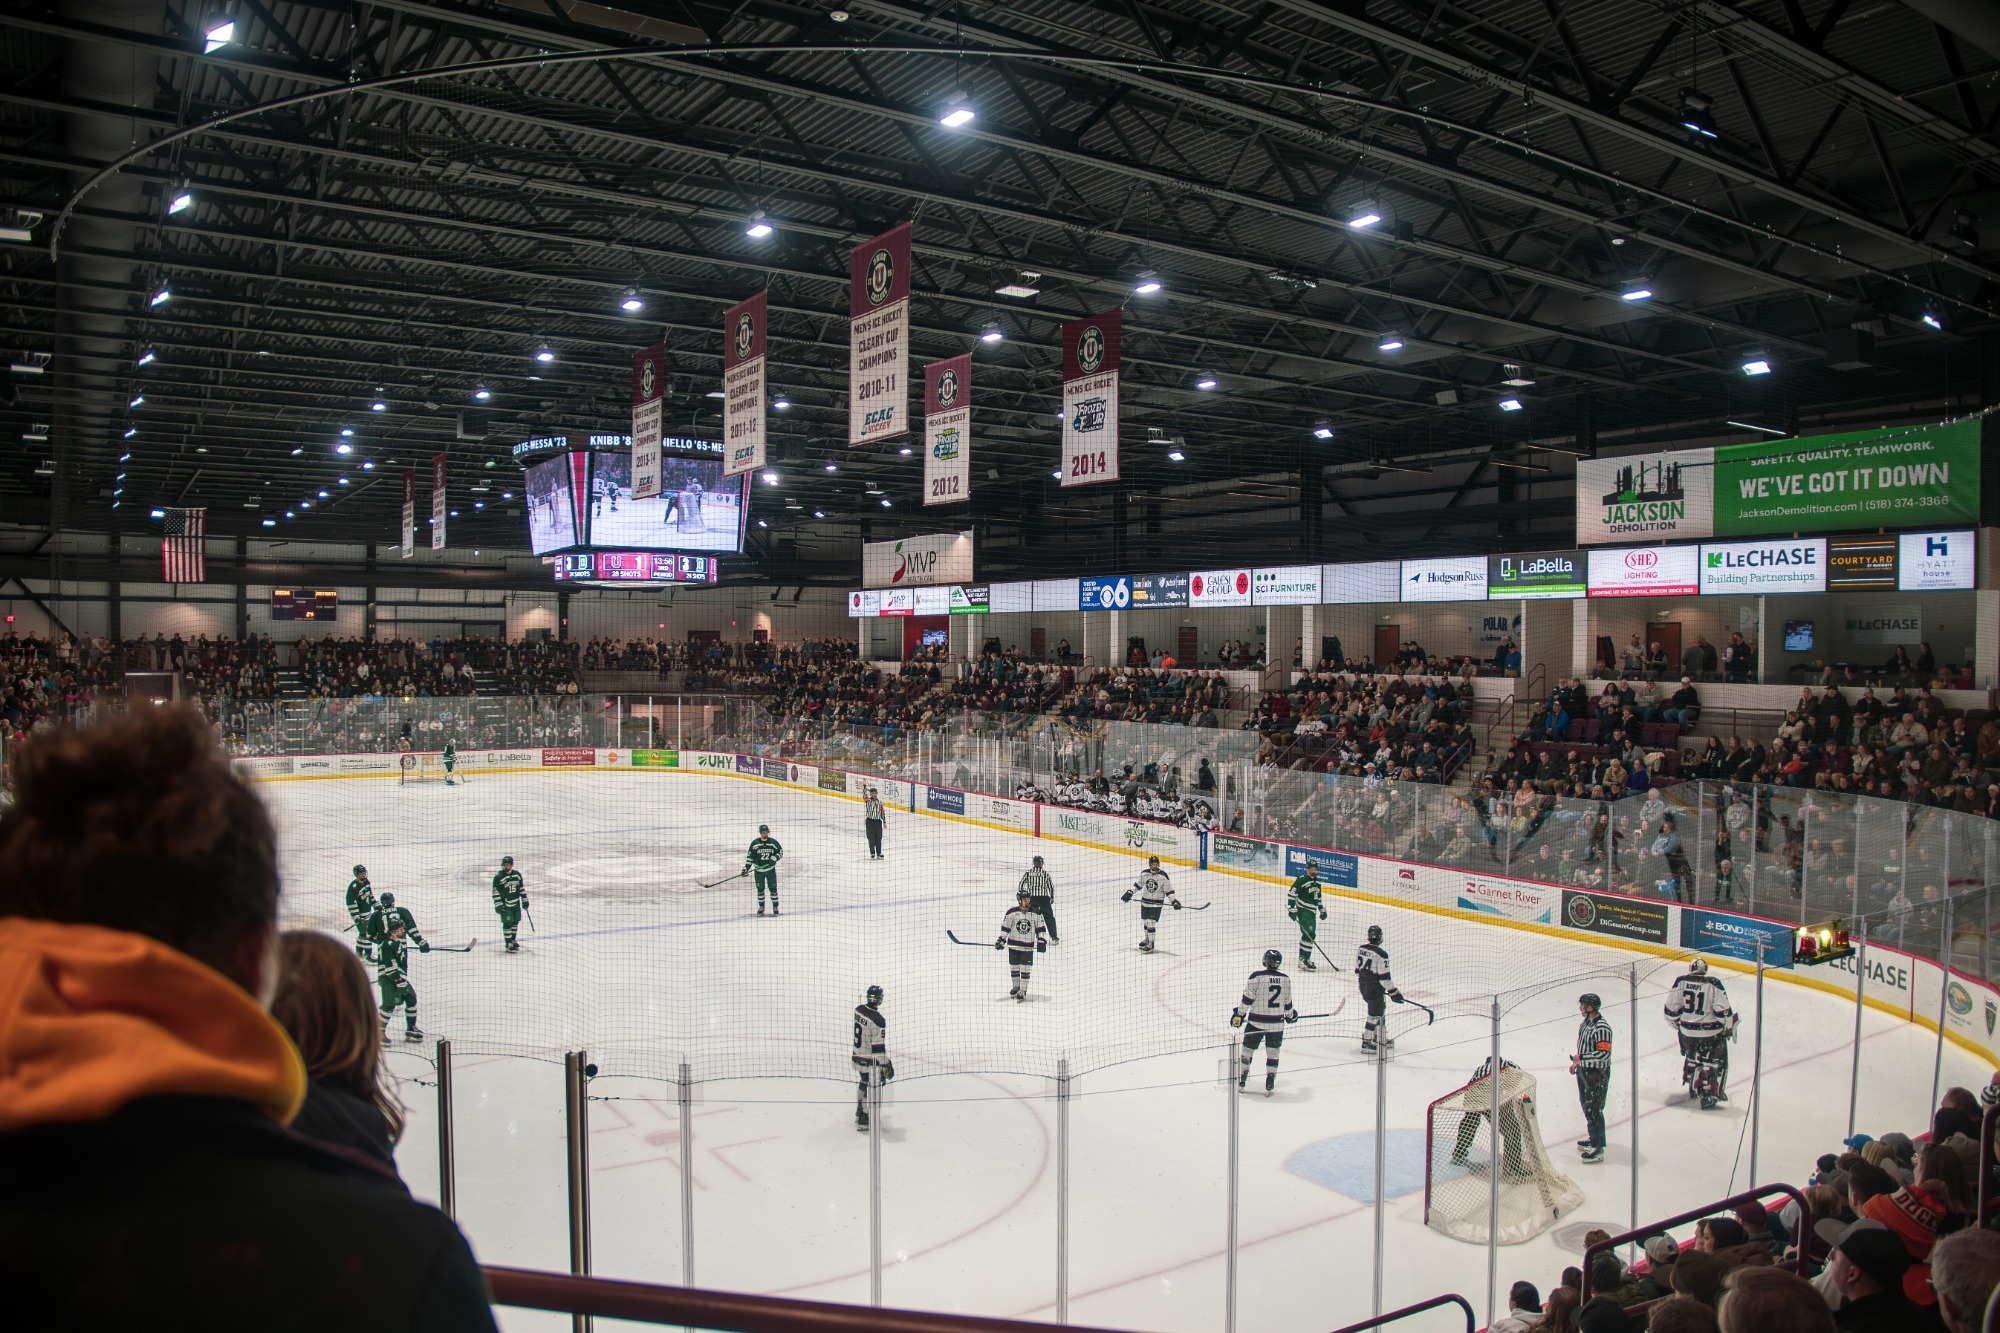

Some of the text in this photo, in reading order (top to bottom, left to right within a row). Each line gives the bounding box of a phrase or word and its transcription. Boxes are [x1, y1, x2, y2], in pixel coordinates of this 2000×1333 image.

[853, 307, 903, 335] MEN'S ICE HOCKEY
[858, 327, 899, 354] CLEARY CUP
[858, 347, 897, 371] CHAMPIONS
[730, 378, 760, 400] CLEARY CUP
[859, 374, 896, 401] 2010-11
[730, 396, 758, 415] CHAMPIONS
[1077, 401, 1106, 417] FROZEN
[864, 405, 895, 426] ECAC
[730, 418, 757, 440] 2011-12
[867, 420, 892, 434] HOCKEY
[554, 436, 566, 447] '73
[590, 435, 633, 446] KNIBB '8
[636, 452, 656, 468] 2013-14
[735, 445, 755, 461] ECAC
[1797, 448, 1852, 464] QUALITY.
[1854, 440, 1935, 457] TEAMWORK.
[1071, 451, 1107, 478] 2014
[932, 475, 959, 497] 2012
[1739, 462, 1949, 499] WE'VE GOT IT DOWN
[1602, 500, 1685, 525] JACKSON
[1738, 501, 1858, 519] JacksonDemolition.com
[1865, 498, 1892, 511] (518)
[1894, 495, 1949, 509] 374-3366
[1609, 521, 1676, 534] DEMOLITION
[635, 556, 642, 570] 1
[682, 556, 690, 571] 3
[906, 550, 937, 575] MVP
[1520, 558, 1573, 574] LaBella
[1830, 556, 1893, 566] COURTYARD
[1917, 560, 1956, 569] HYATT
[1624, 570, 1658, 580] LIGHTING
[1707, 573, 1749, 586] Building
[1114, 577, 1130, 608] 6
[1206, 585, 1232, 596] GROUP
[1256, 583, 1316, 594] SCI FURNITURE
[1483, 616, 1508, 631] POLAR
[500, 753, 532, 762] LaBella
[708, 754, 733, 770] UHY
[935, 792, 962, 804] FENIMORE
[1058, 813, 1104, 836] M&T Bank
[1124, 827, 1148, 838] JACKSON
[1228, 839, 1250, 848] RECOVERY
[1478, 884, 1512, 900] Garnet
[1515, 889, 1542, 906] River
[1599, 918, 1661, 936] DiGesareGroup.com
[1715, 921, 1744, 935] BOND
[1267, 984, 1282, 1009] 2
[1682, 989, 1706, 1016] 31
